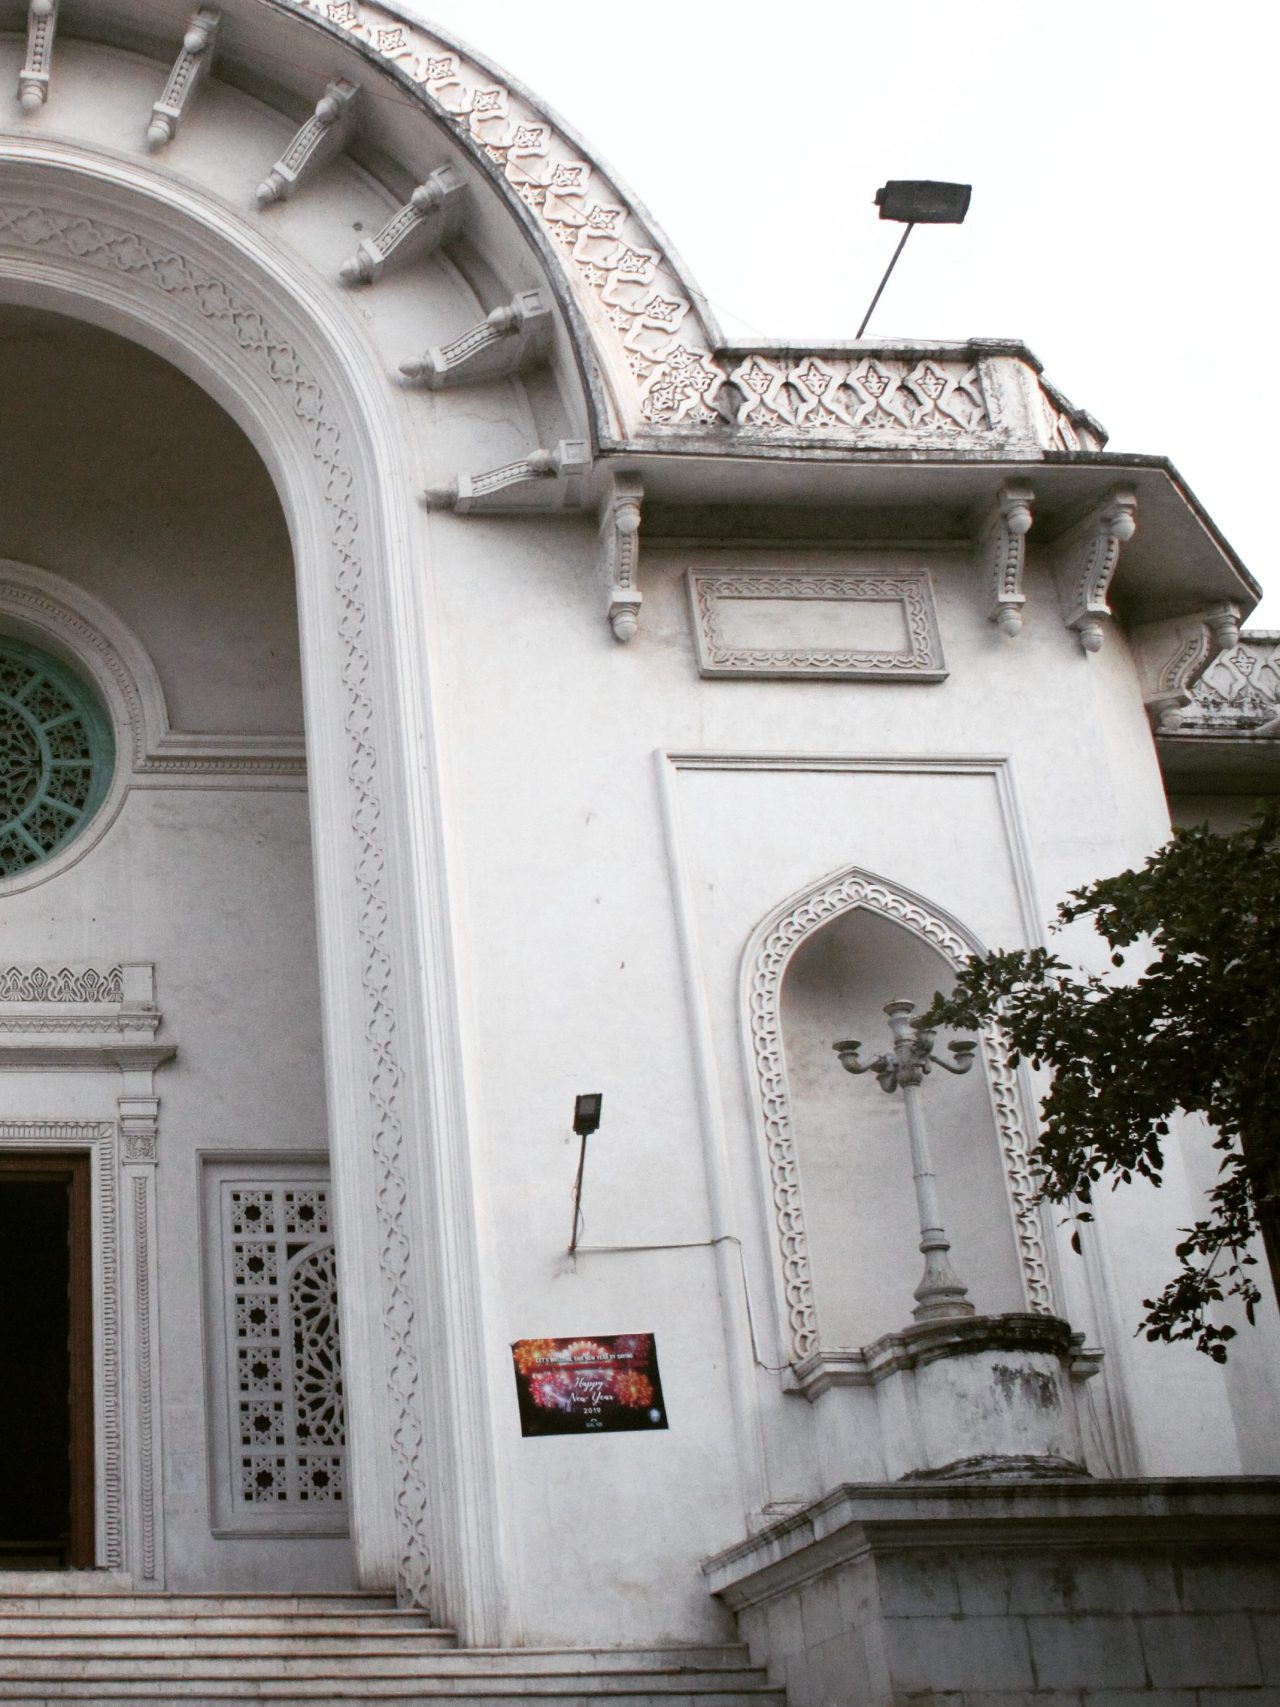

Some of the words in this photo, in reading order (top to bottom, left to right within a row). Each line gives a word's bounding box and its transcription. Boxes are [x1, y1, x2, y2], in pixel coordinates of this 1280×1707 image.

[575, 1377, 603, 1392] Happy
[569, 1392, 590, 1404] New
[591, 1391, 613, 1405] Year
